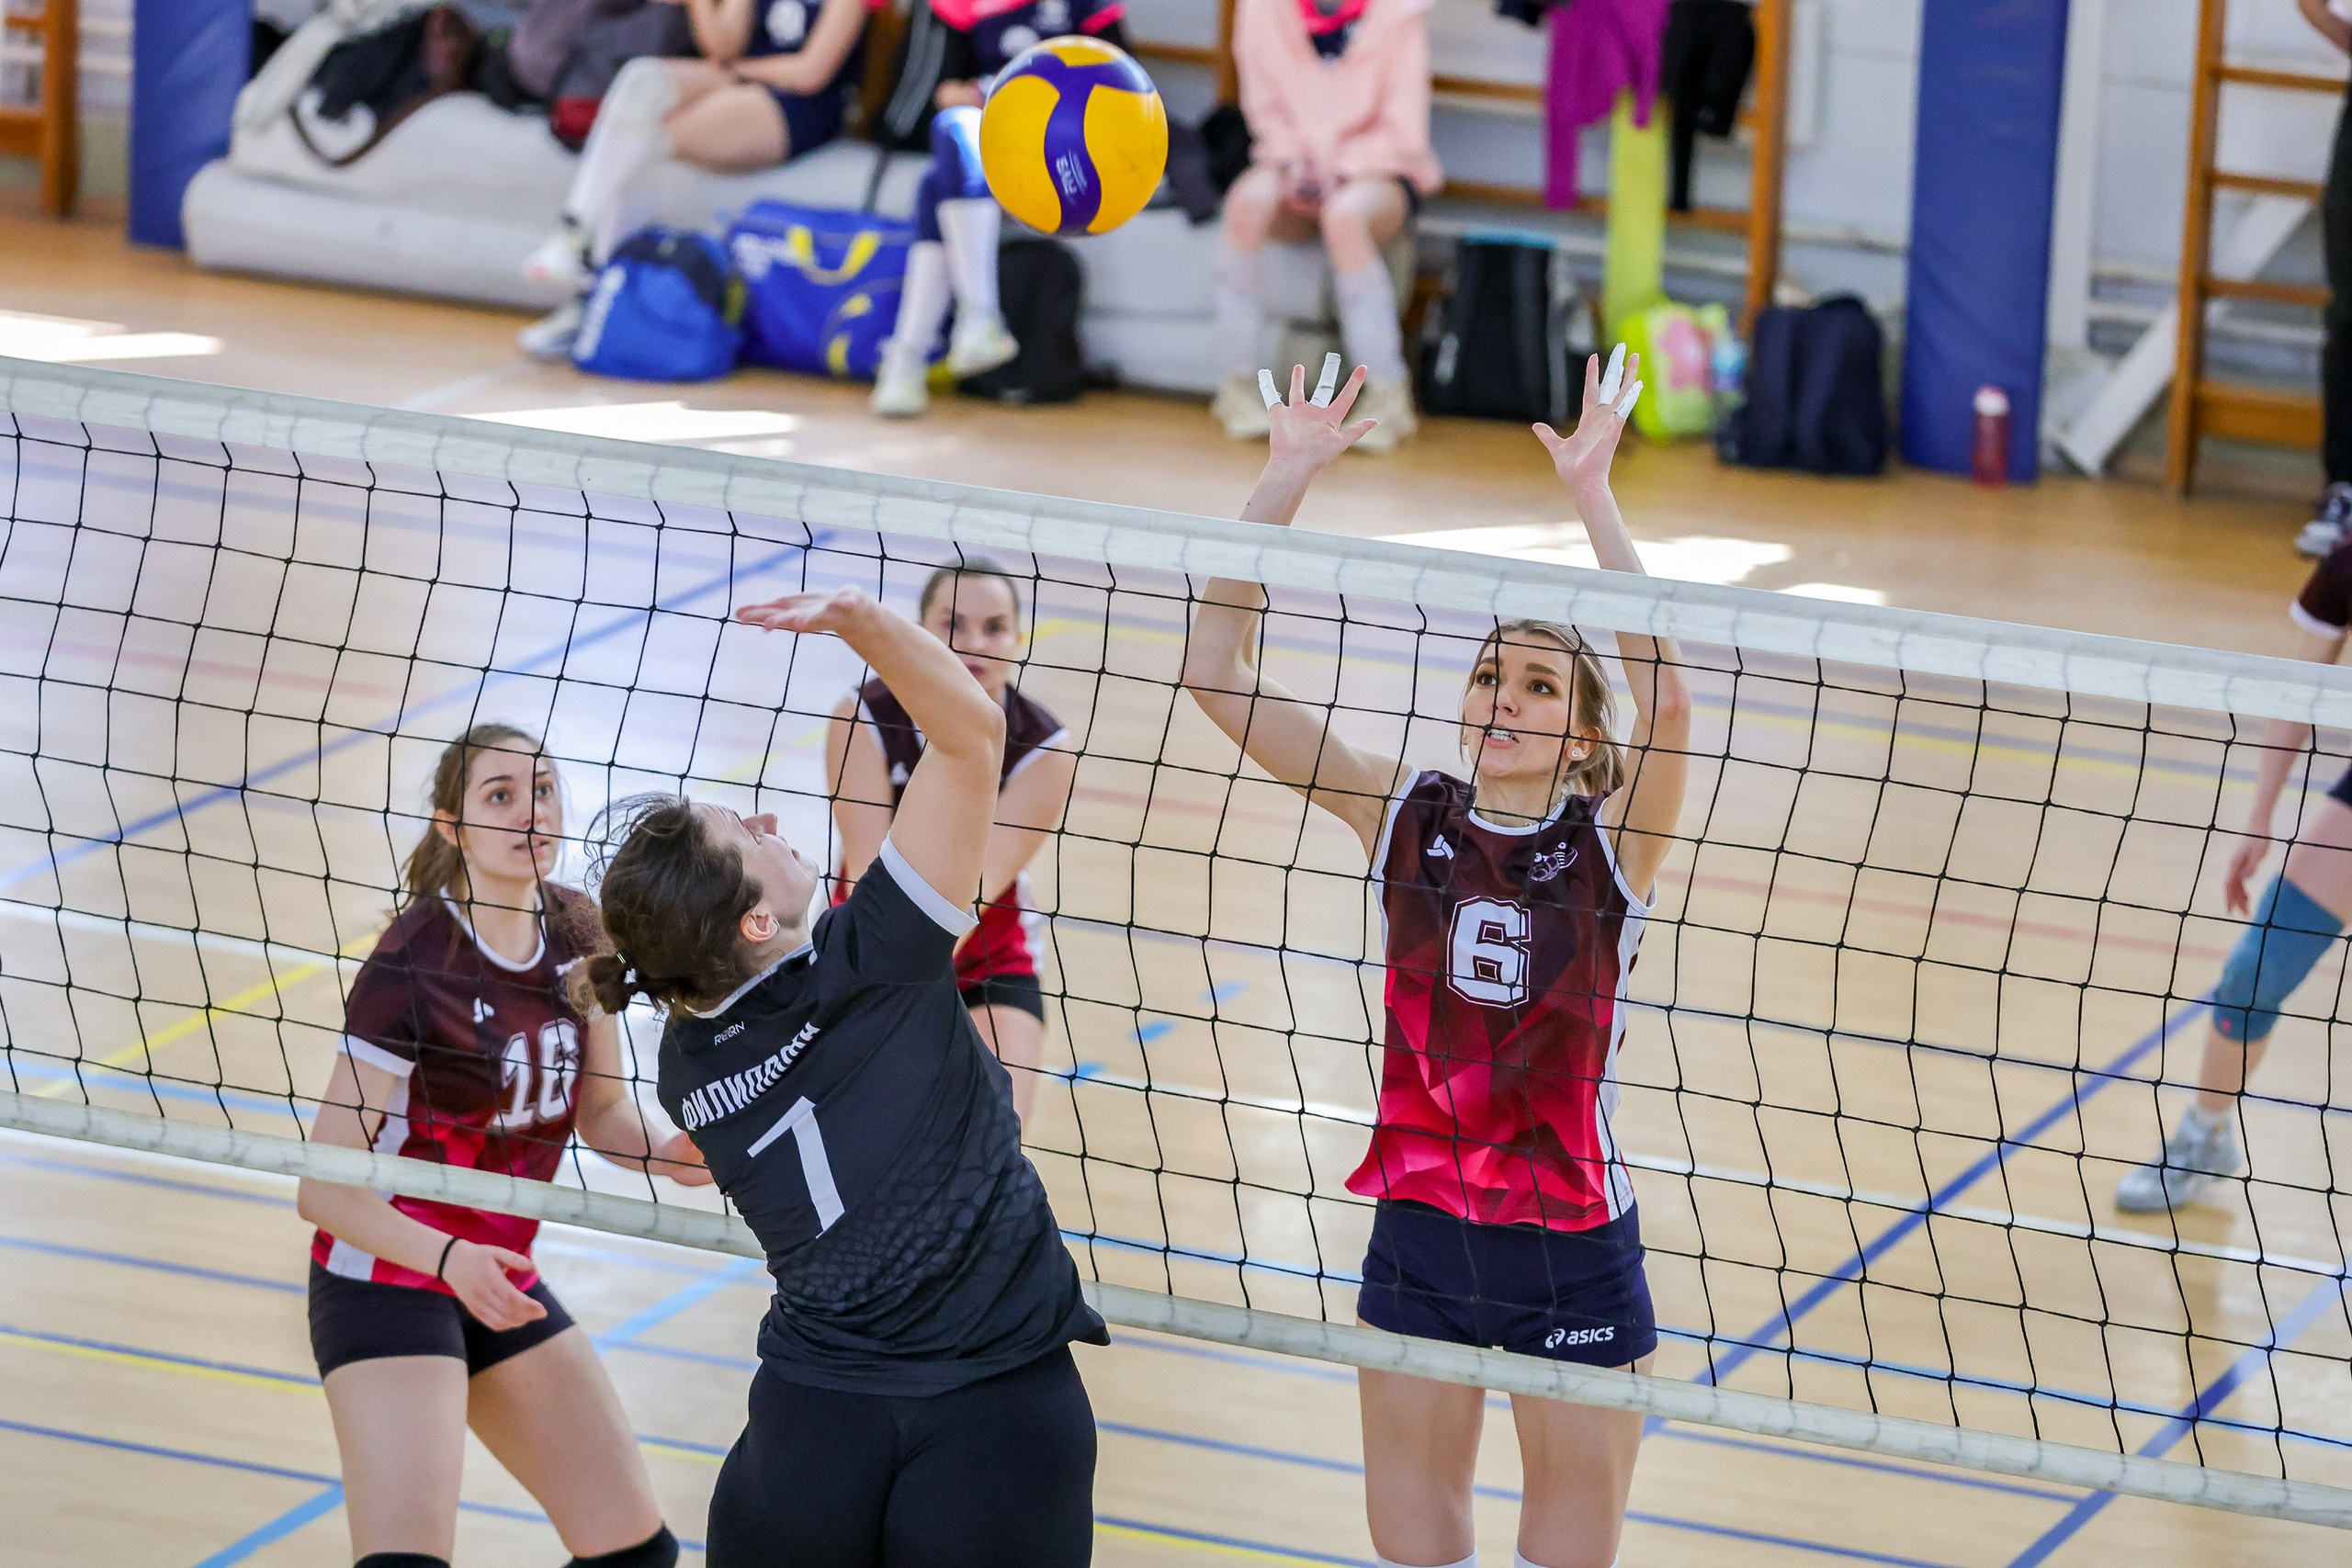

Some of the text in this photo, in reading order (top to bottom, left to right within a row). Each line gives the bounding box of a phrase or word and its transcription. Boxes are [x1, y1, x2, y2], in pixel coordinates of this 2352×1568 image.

[1447, 896, 1532, 1009] 6
[486, 1018, 580, 1131] 16
[747, 1096, 845, 1238] 7
